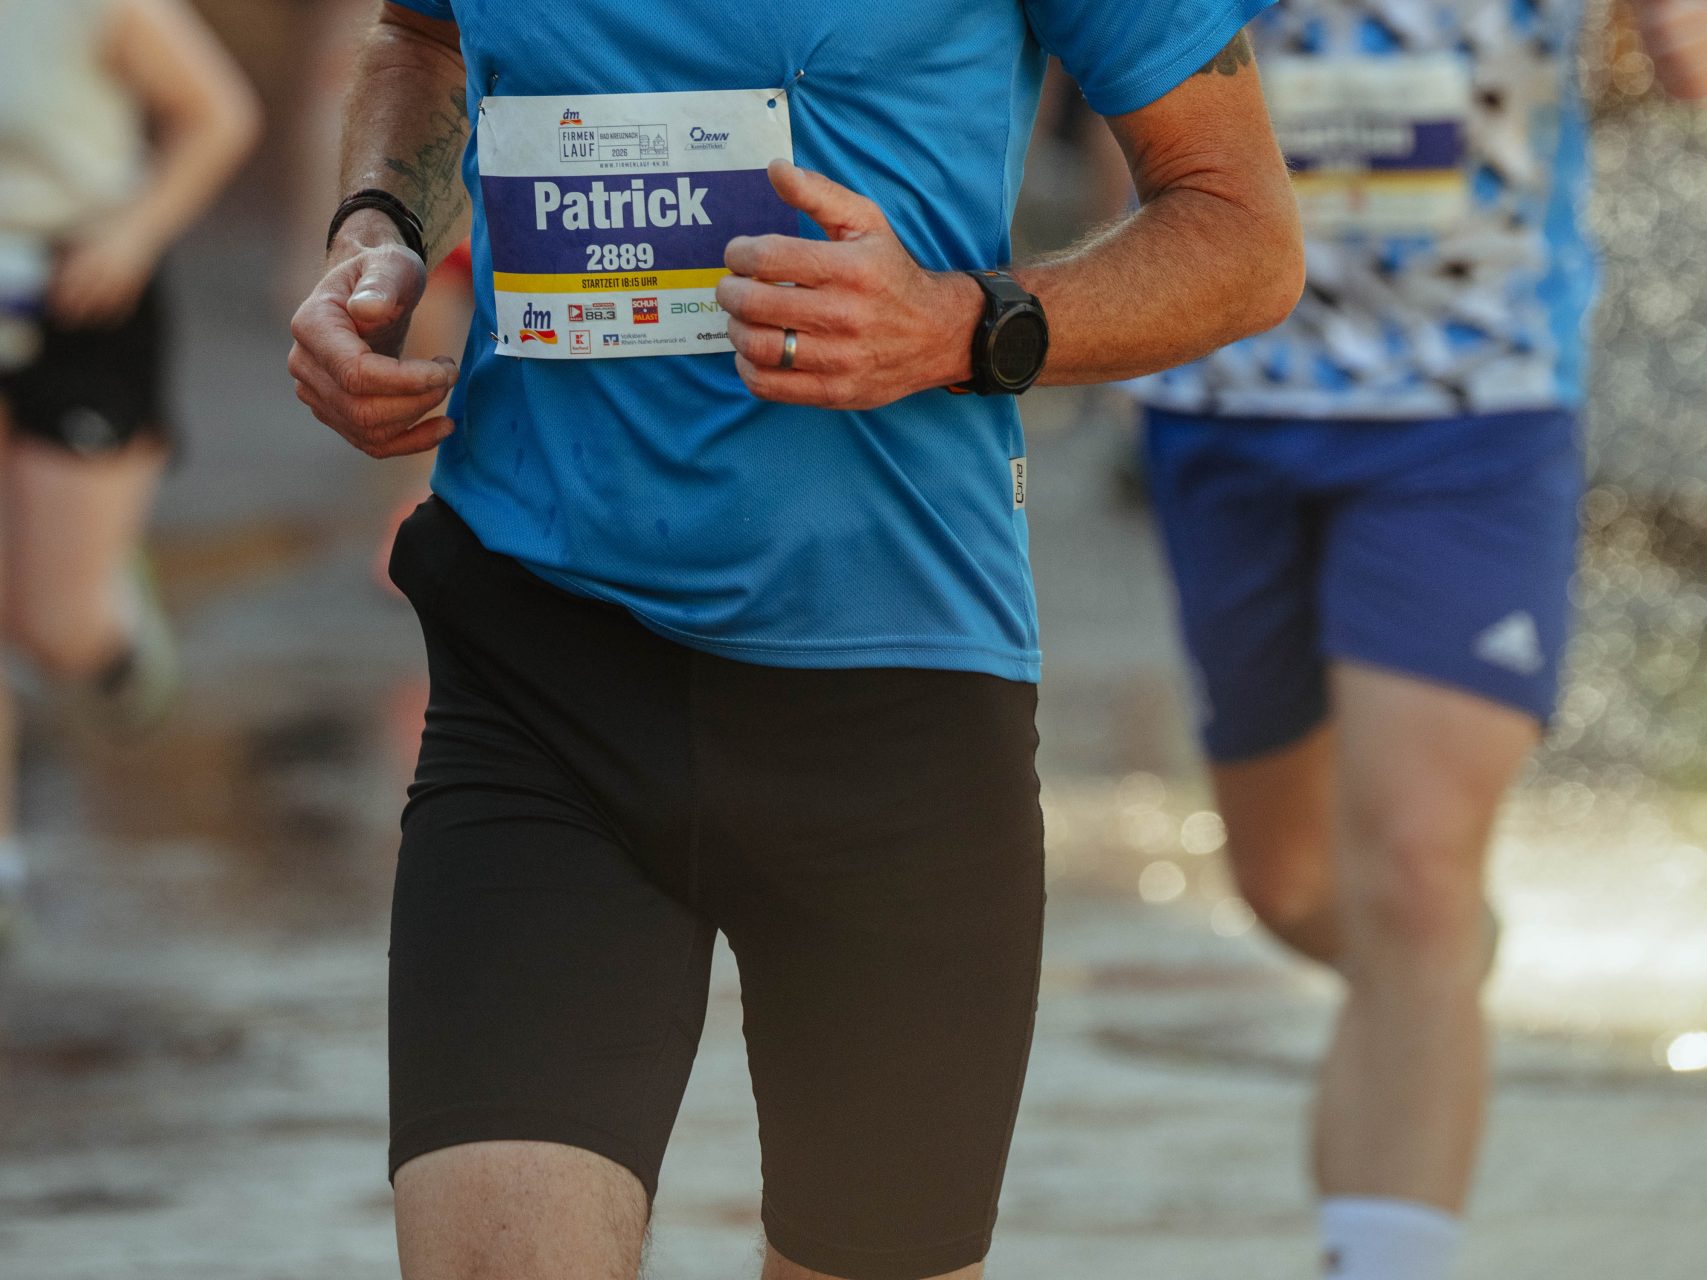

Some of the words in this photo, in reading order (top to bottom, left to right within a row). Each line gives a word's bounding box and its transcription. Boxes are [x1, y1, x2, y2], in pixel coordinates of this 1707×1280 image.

[563, 108, 580, 120] dm
[563, 131, 595, 142] FIRMEN
[610, 132, 638, 140] KREUZNACH
[563, 143, 596, 158] LAUF
[533, 177, 713, 231] Patrick
[586, 242, 655, 271] 2889
[582, 277, 619, 289] STARTZEIT
[621, 277, 640, 288] 18:15
[641, 276, 658, 287] UHR
[632, 300, 657, 308] SCHUH
[523, 302, 551, 330] dm
[585, 311, 616, 320] 88.3
